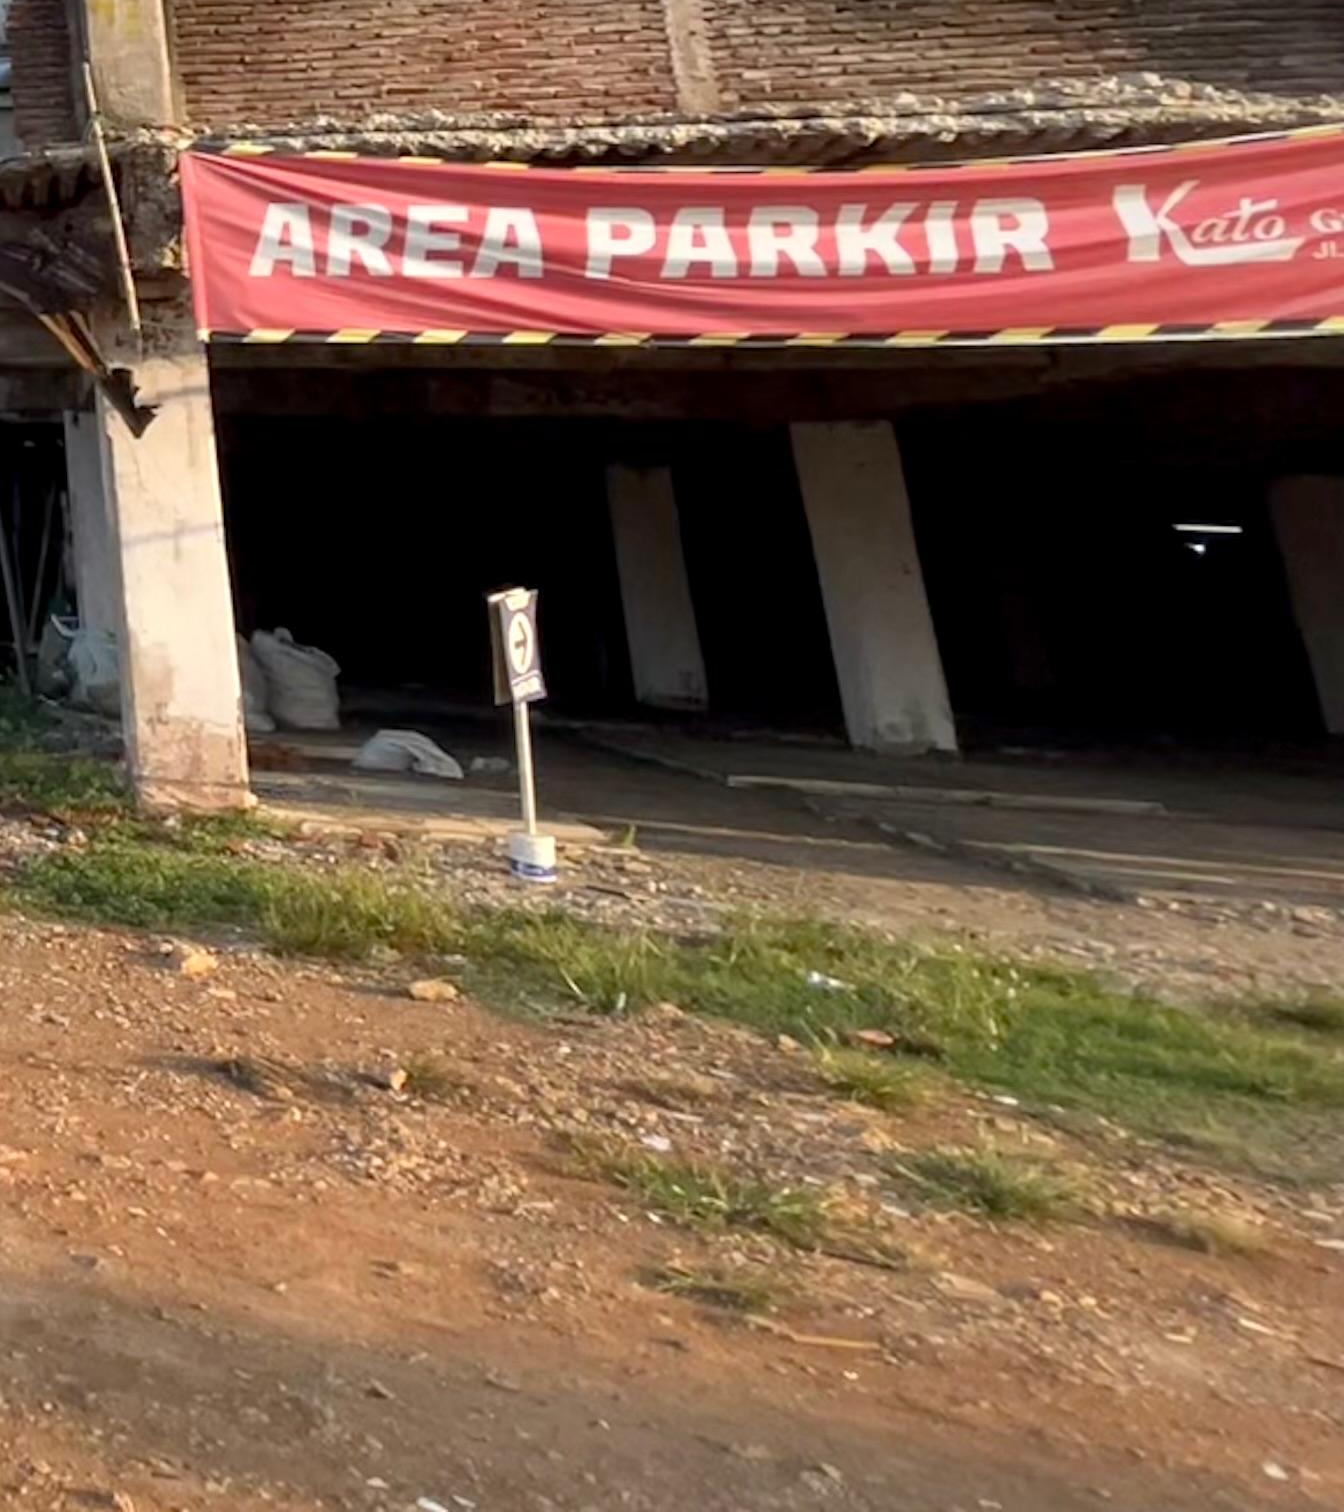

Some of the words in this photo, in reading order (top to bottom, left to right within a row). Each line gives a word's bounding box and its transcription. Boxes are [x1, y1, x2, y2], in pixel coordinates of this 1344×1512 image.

[248, 201, 544, 279] AREA
[583, 197, 1055, 280] PARKIR
[1112, 179, 1307, 266] Kato
